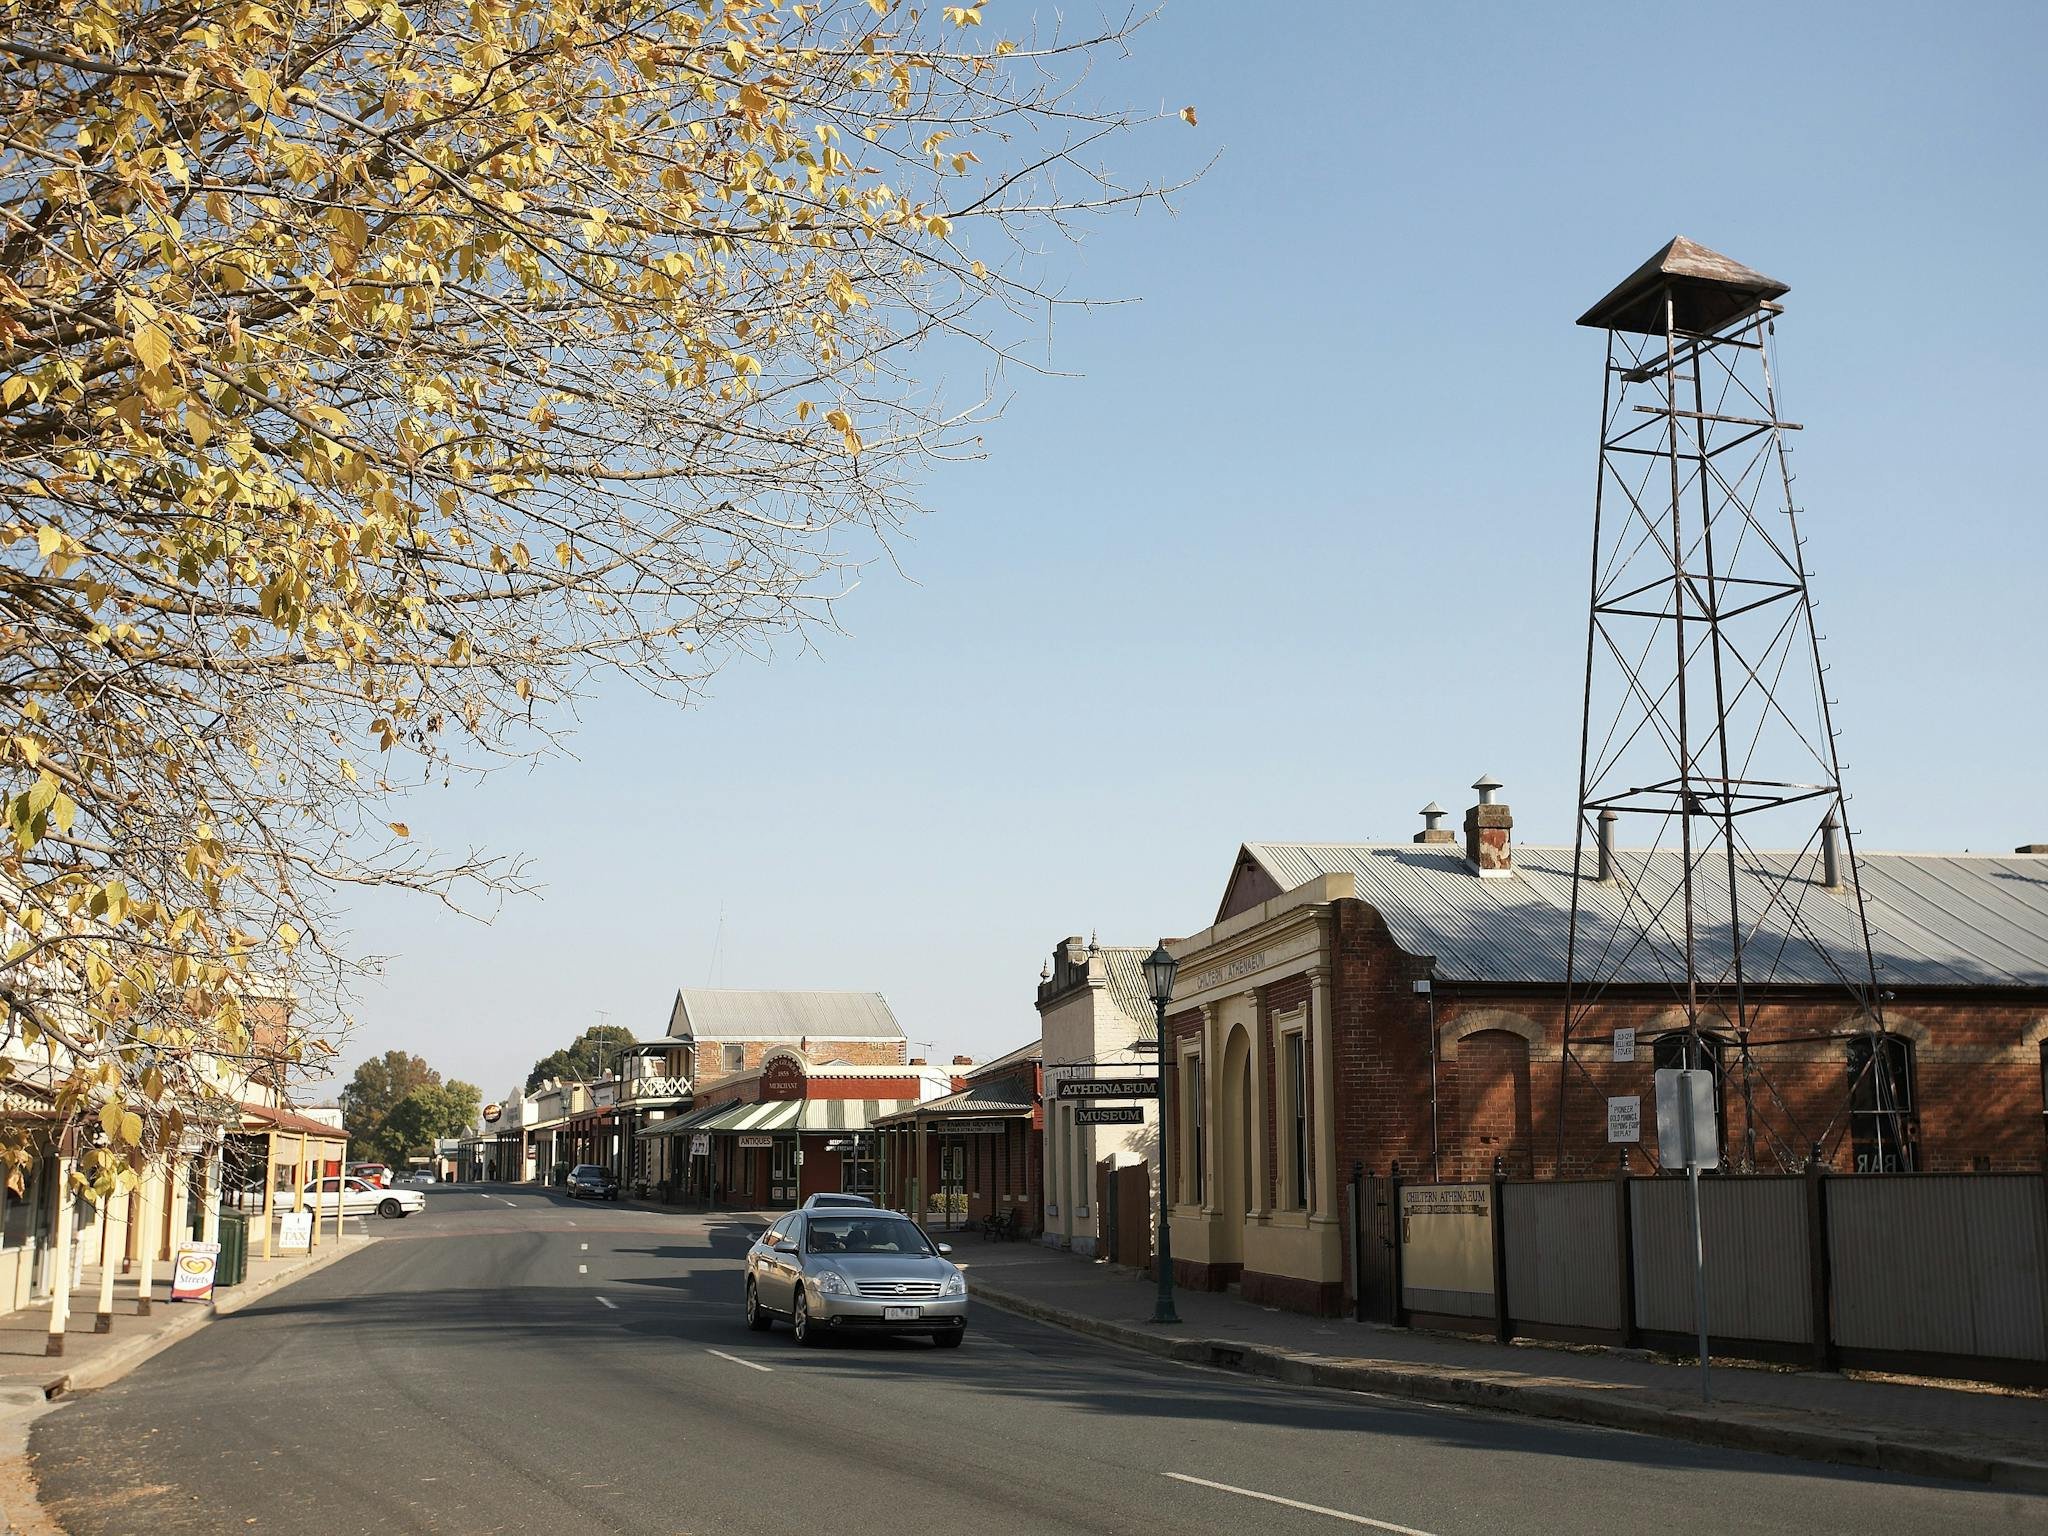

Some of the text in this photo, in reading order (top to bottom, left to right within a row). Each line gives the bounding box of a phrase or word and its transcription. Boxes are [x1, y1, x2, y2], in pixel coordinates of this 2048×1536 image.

[1227, 952, 1266, 979] ATHENAEUM
[1061, 1083, 1157, 1095] ATHENAEUM
[1079, 1110, 1140, 1122] MUSEUM
[740, 1137, 771, 1146] ANTIQUES
[1406, 1190, 1485, 1203] CHILTERN ATHENAEUM
[283, 1231, 307, 1241] TAX
[179, 1274, 209, 1284] Streets
